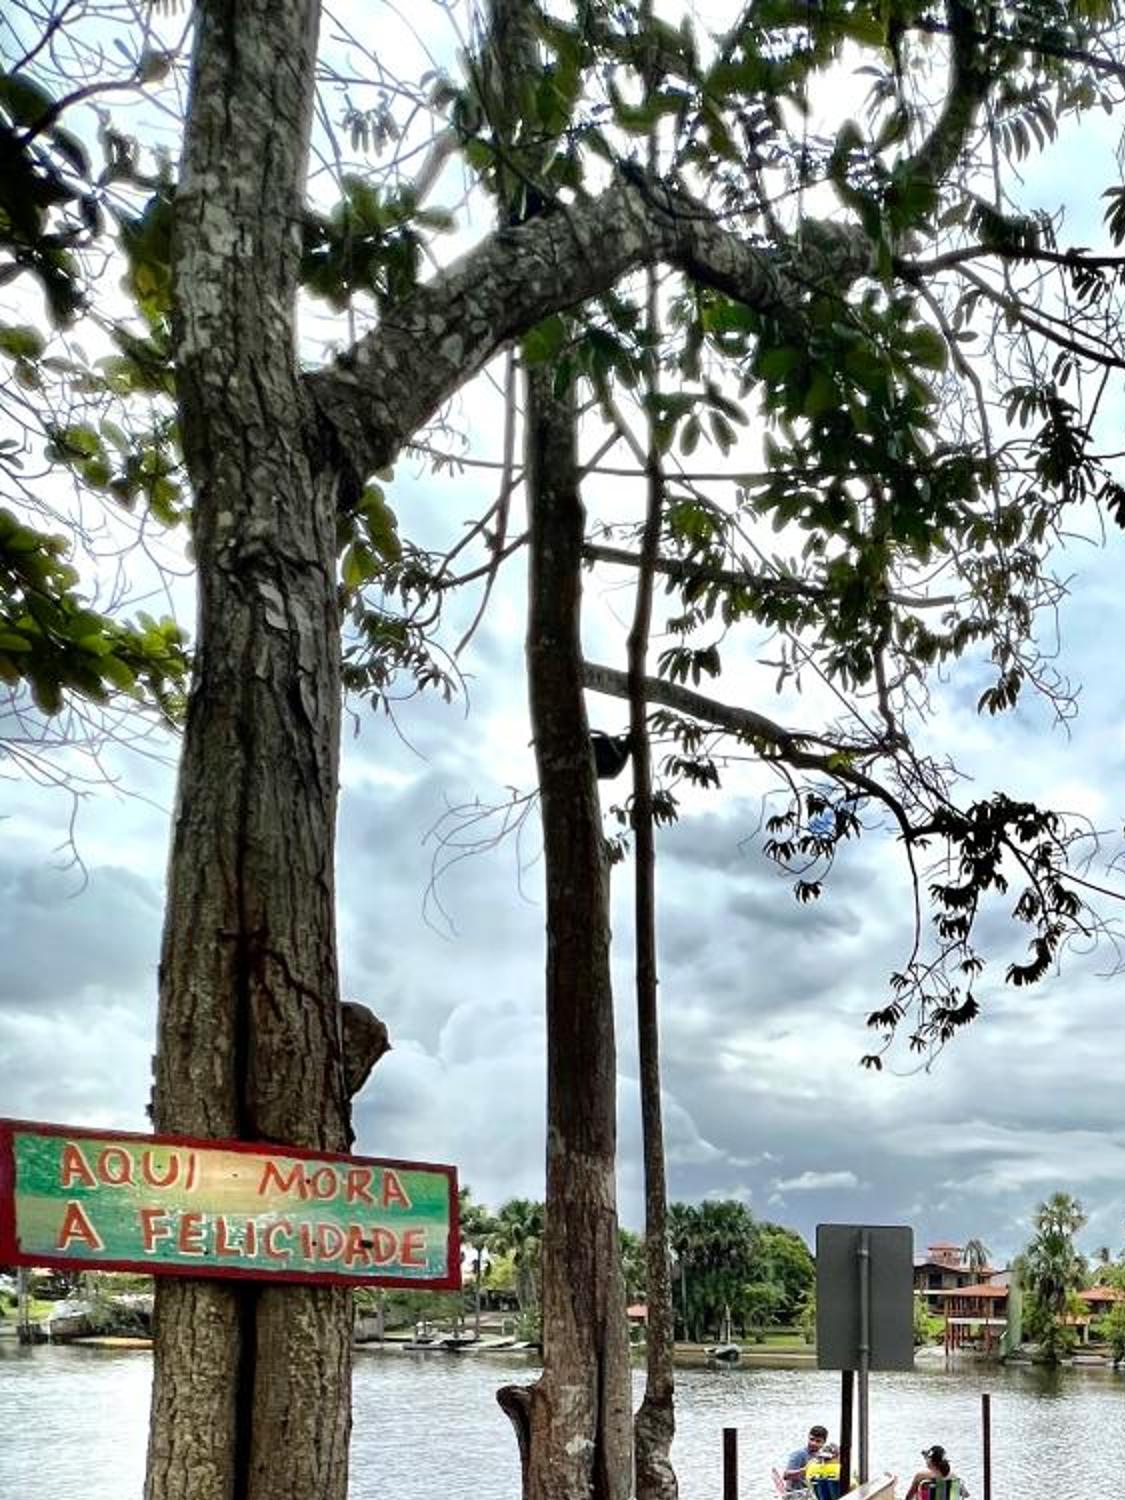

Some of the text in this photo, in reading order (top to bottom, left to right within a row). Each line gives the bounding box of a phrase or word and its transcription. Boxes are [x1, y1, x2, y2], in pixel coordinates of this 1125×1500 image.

[60, 1141, 412, 1208] AQUI MORA
[56, 1199, 428, 1266] A FELICIDADE
